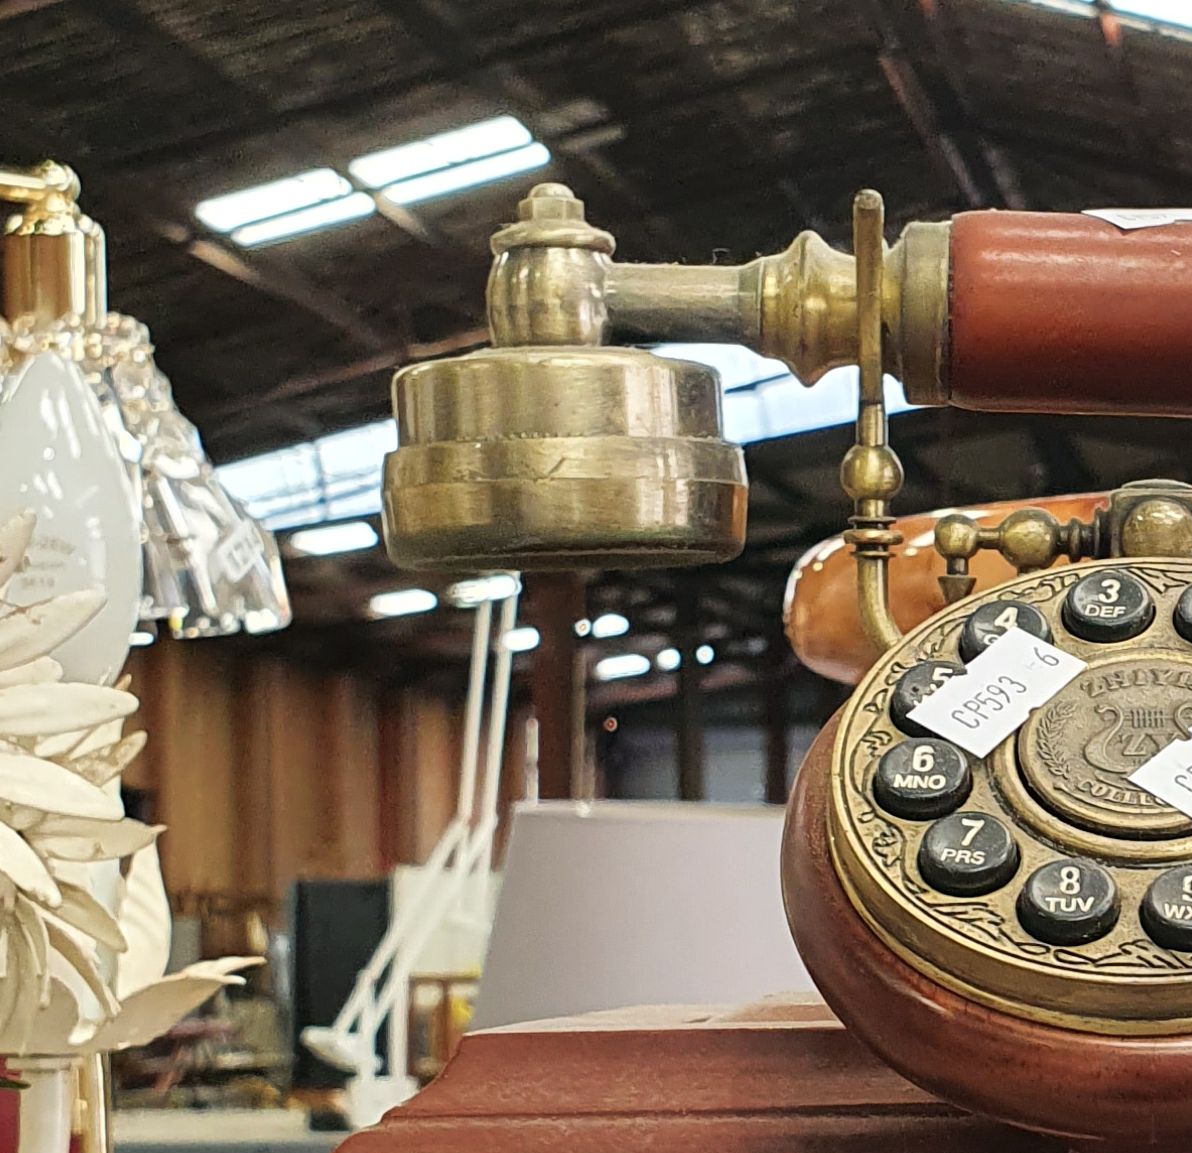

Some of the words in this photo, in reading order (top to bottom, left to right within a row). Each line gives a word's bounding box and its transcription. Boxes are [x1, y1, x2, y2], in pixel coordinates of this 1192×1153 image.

[1098, 578, 1121, 603] 3
[994, 606, 1019, 628] 4
[1084, 604, 1127, 618] DEF
[950, 675, 1028, 729] CP593
[1033, 646, 1060, 667] 6
[912, 744, 935, 773] 6
[893, 774, 947, 790] MNO
[960, 818, 986, 846] 7
[940, 849, 986, 866] PRS
[1059, 866, 1081, 895] 8
[1044, 896, 1095, 913] TUV
